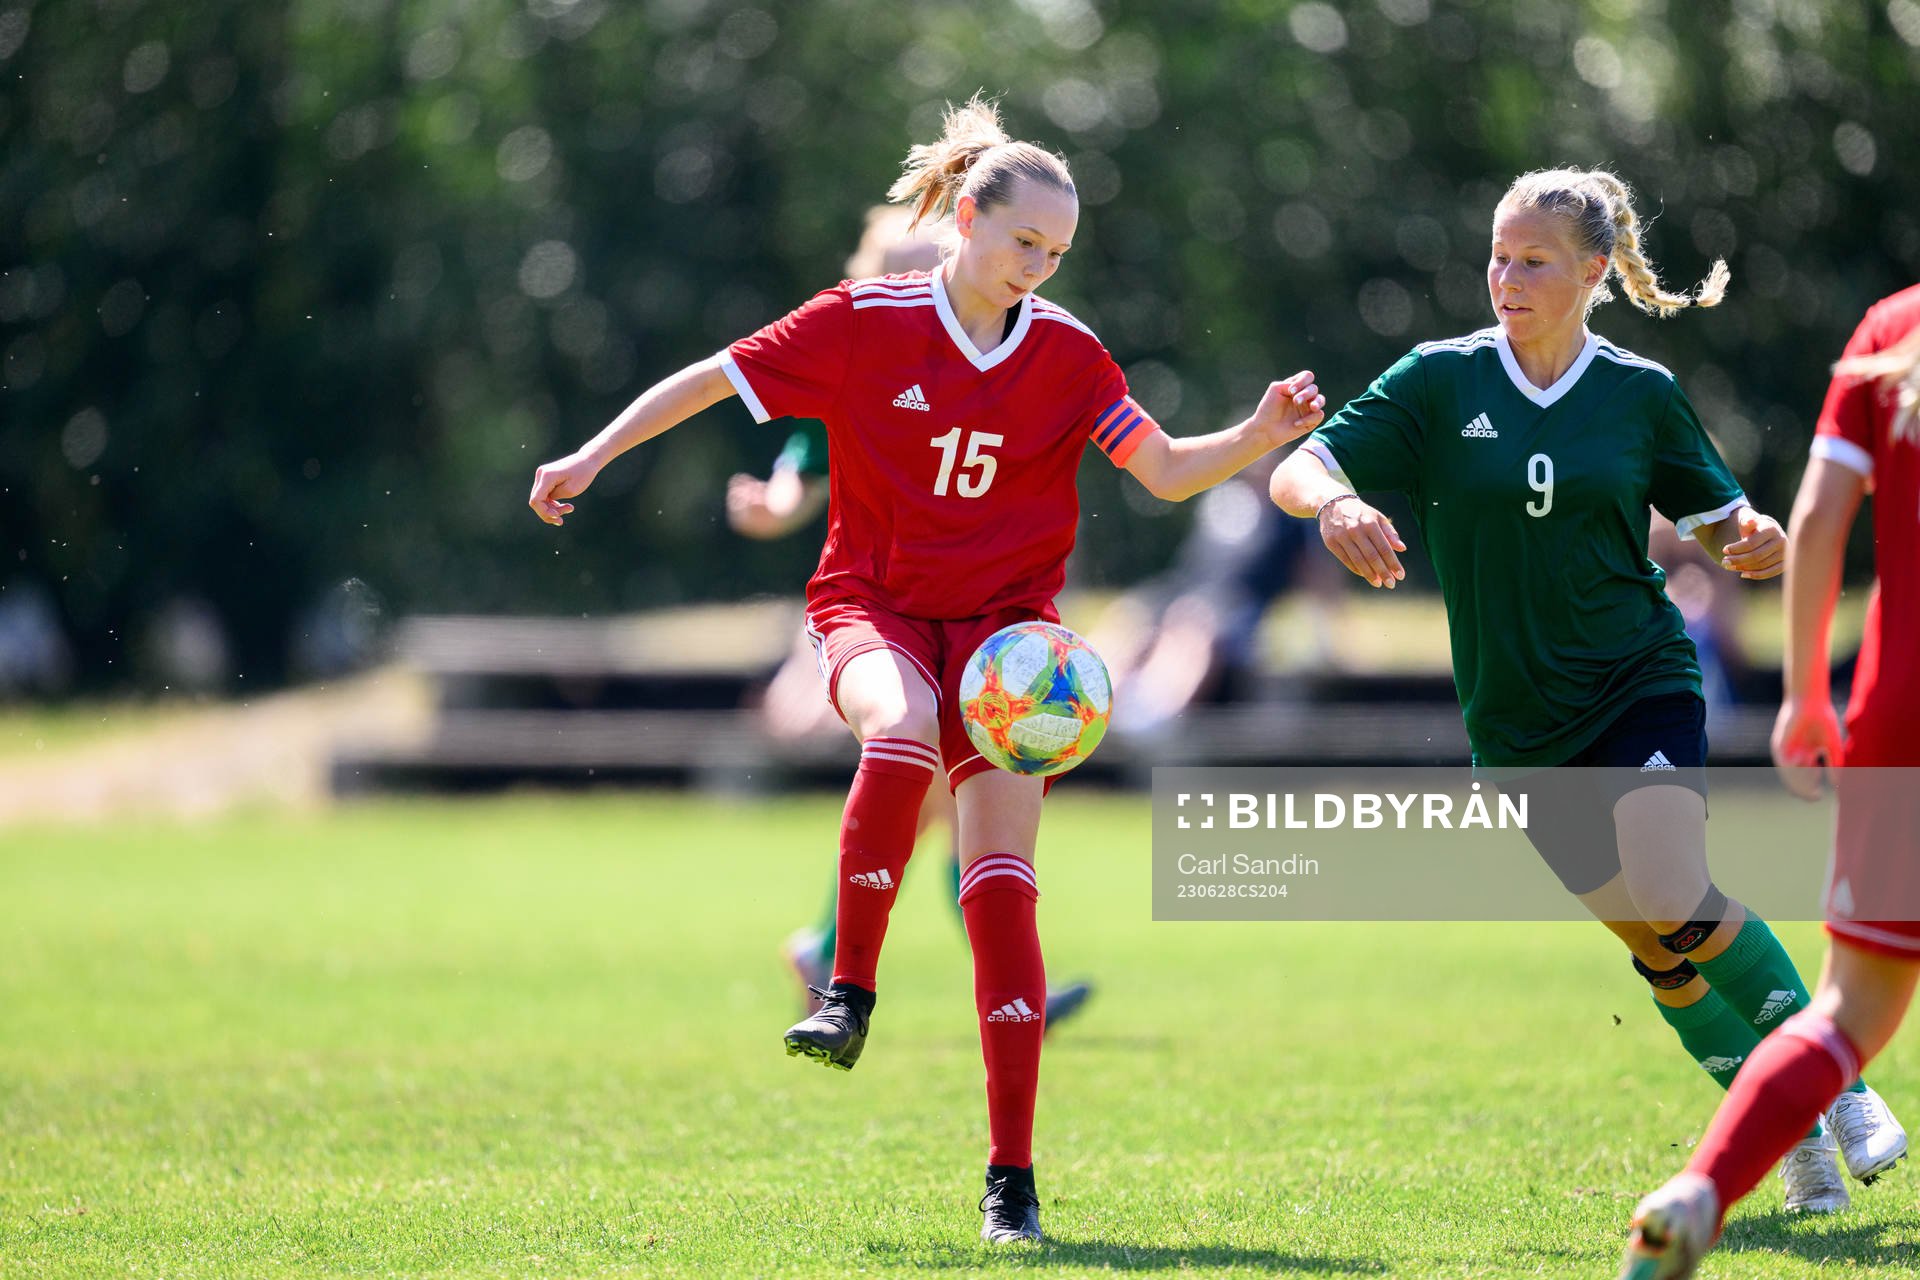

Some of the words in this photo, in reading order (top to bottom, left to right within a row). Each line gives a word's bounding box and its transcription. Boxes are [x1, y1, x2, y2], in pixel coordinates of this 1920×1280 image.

[893, 399, 930, 412] adidas
[1461, 428, 1499, 438] adidas
[930, 427, 1004, 498] 15
[1526, 453, 1554, 517] 9
[850, 876, 895, 890] adidas
[1753, 989, 1797, 1025] adidas
[987, 1012, 1040, 1022] adidas
